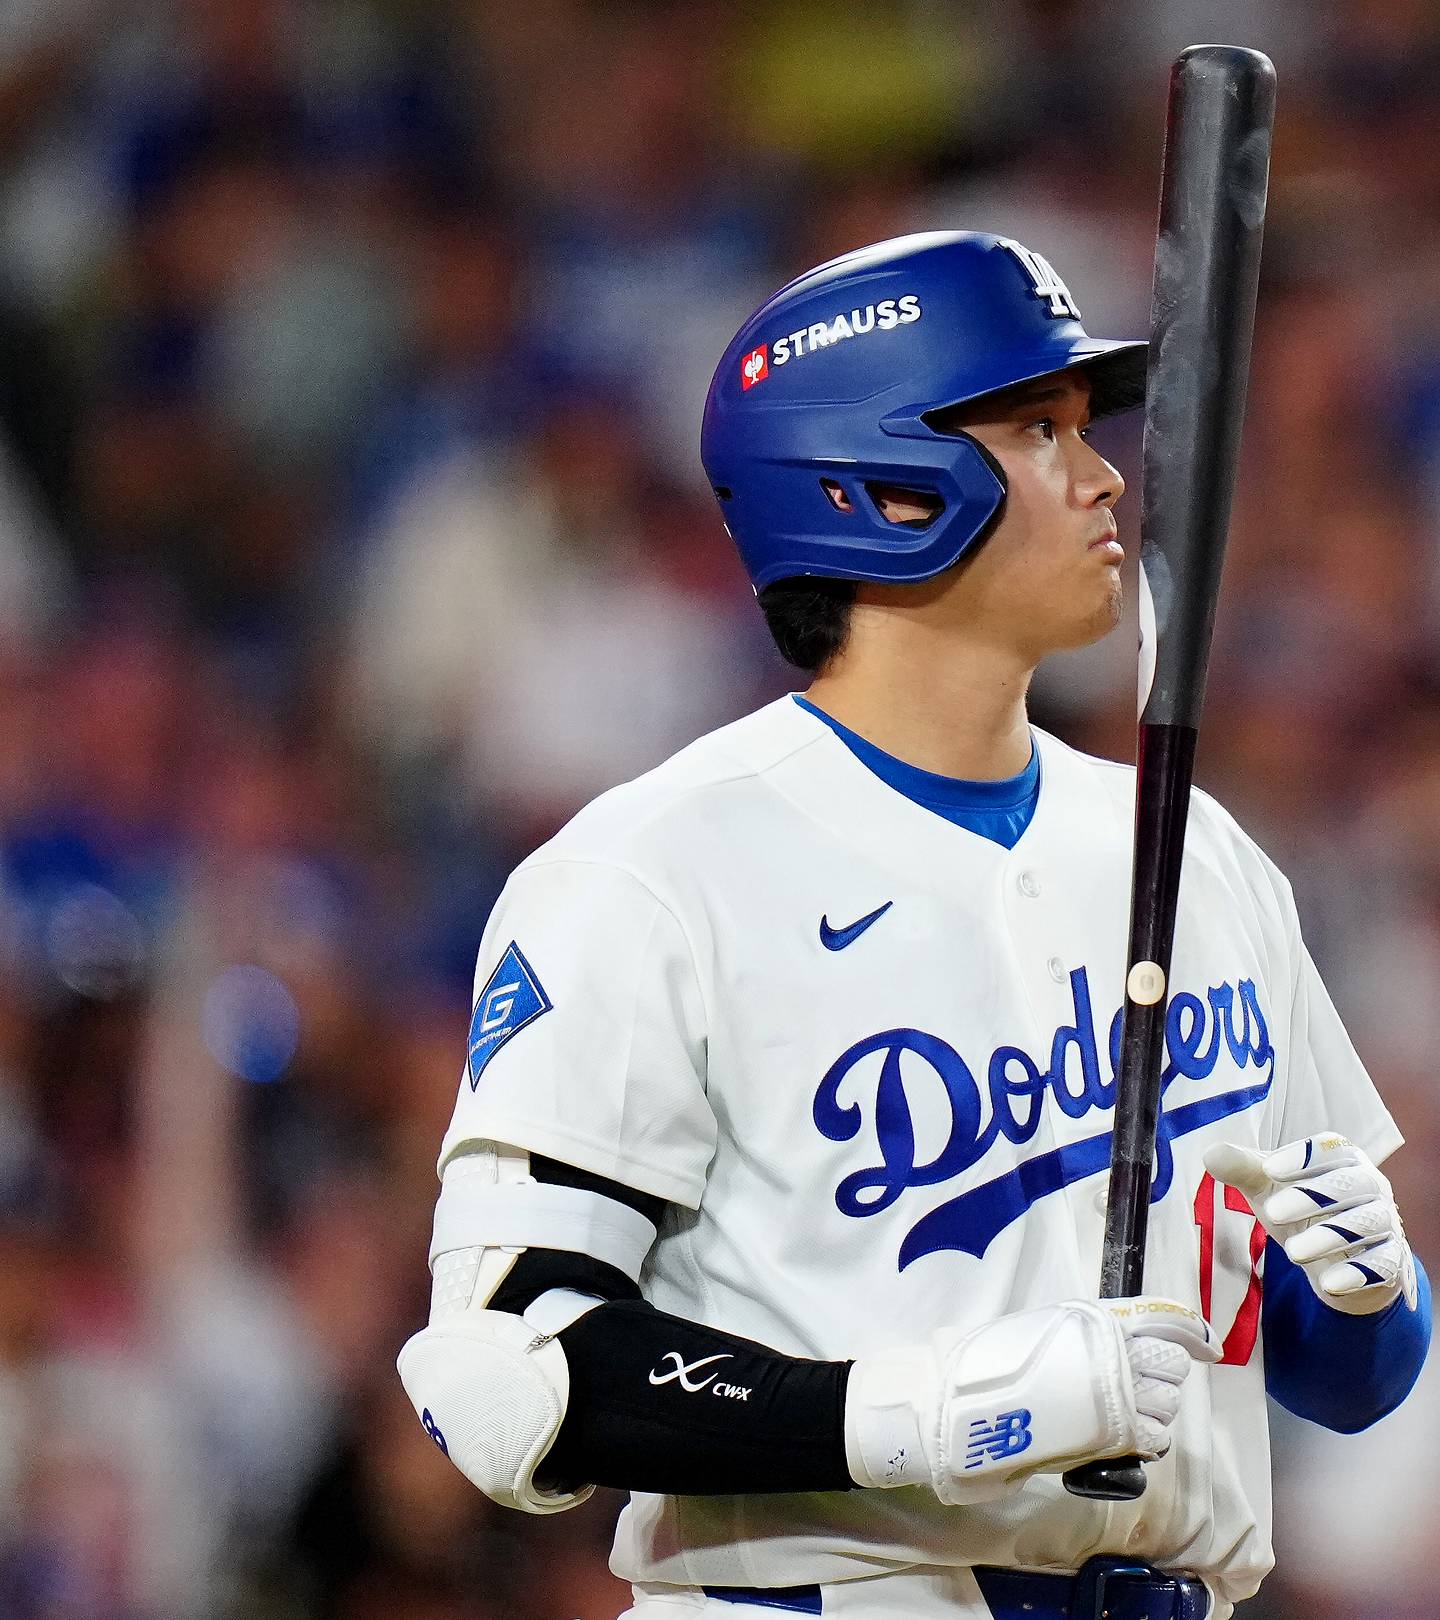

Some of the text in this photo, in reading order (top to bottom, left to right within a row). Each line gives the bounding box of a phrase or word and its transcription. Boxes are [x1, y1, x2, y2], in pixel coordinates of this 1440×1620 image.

[772, 294, 922, 367] STRAUSS
[480, 981, 522, 1034] G
[1193, 1169, 1269, 1367] 17
[712, 1382, 753, 1401] CW-X
